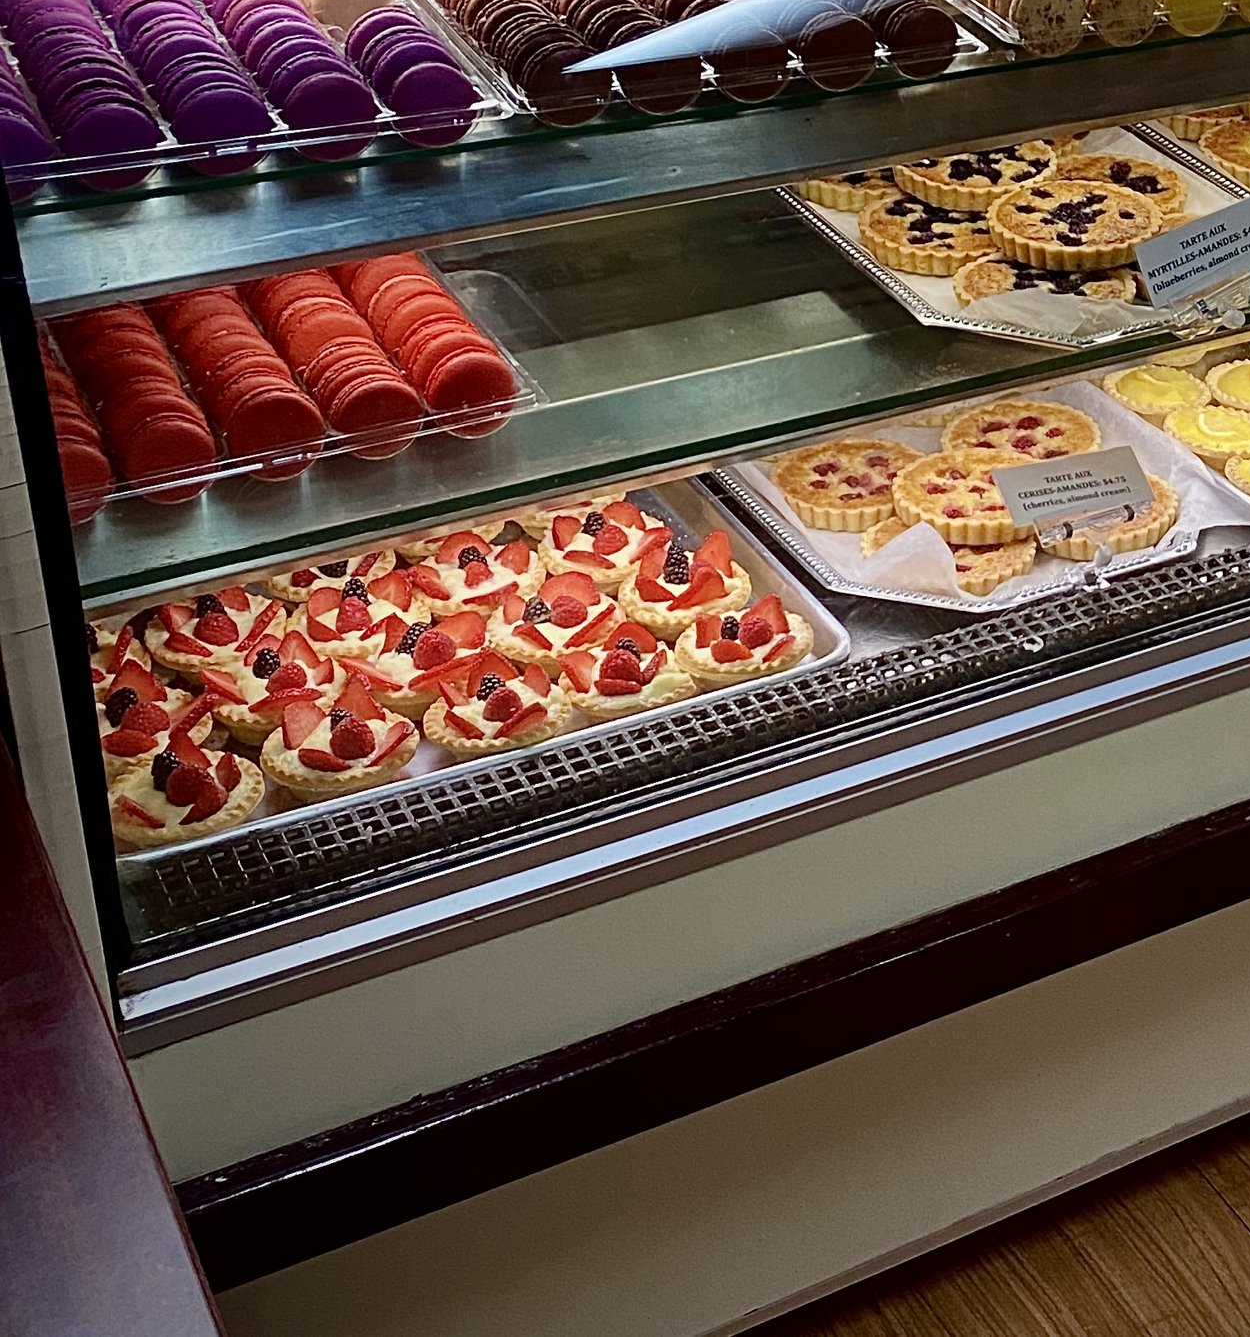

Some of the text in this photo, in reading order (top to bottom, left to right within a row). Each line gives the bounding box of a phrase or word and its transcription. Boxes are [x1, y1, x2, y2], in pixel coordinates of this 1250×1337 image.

[1179, 223, 1227, 250] TARTE AUX
[1147, 232, 1242, 280] MYRTILLES-AMANDES:
[1152, 264, 1208, 294] (blueberries,
[1208, 248, 1240, 268] almond
[1018, 476, 1127, 500] CERISES-AMANDES: $4.75
[1043, 469, 1093, 484] TARTE AUX
[1022, 486, 1131, 511] (cherries, almond cream)
